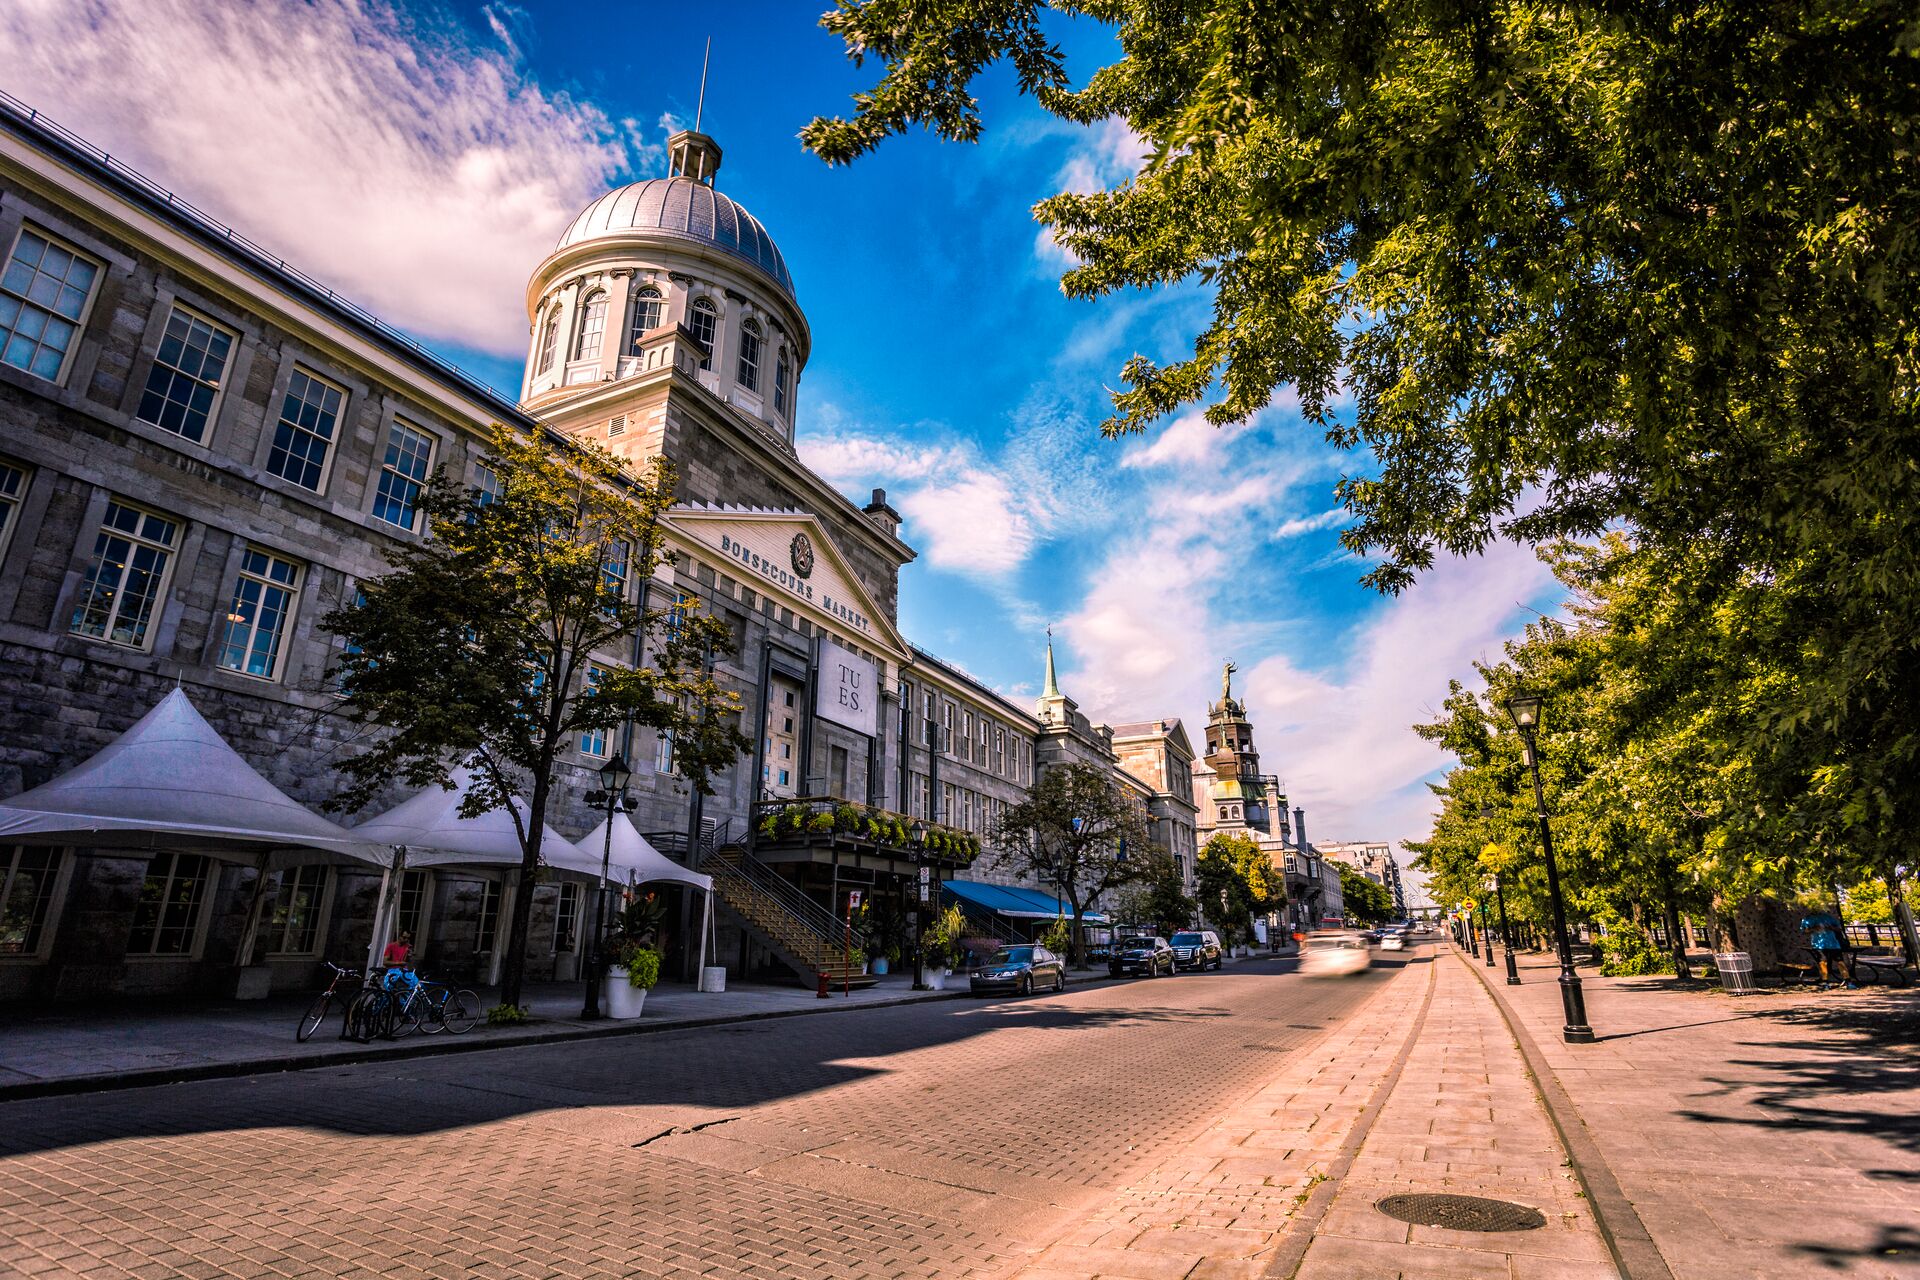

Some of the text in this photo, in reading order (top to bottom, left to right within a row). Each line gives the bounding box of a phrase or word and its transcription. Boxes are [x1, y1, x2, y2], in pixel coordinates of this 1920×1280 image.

[721, 534, 813, 599] BONSECOURS
[838, 664, 861, 689] TU
[838, 687, 863, 712] ES.
